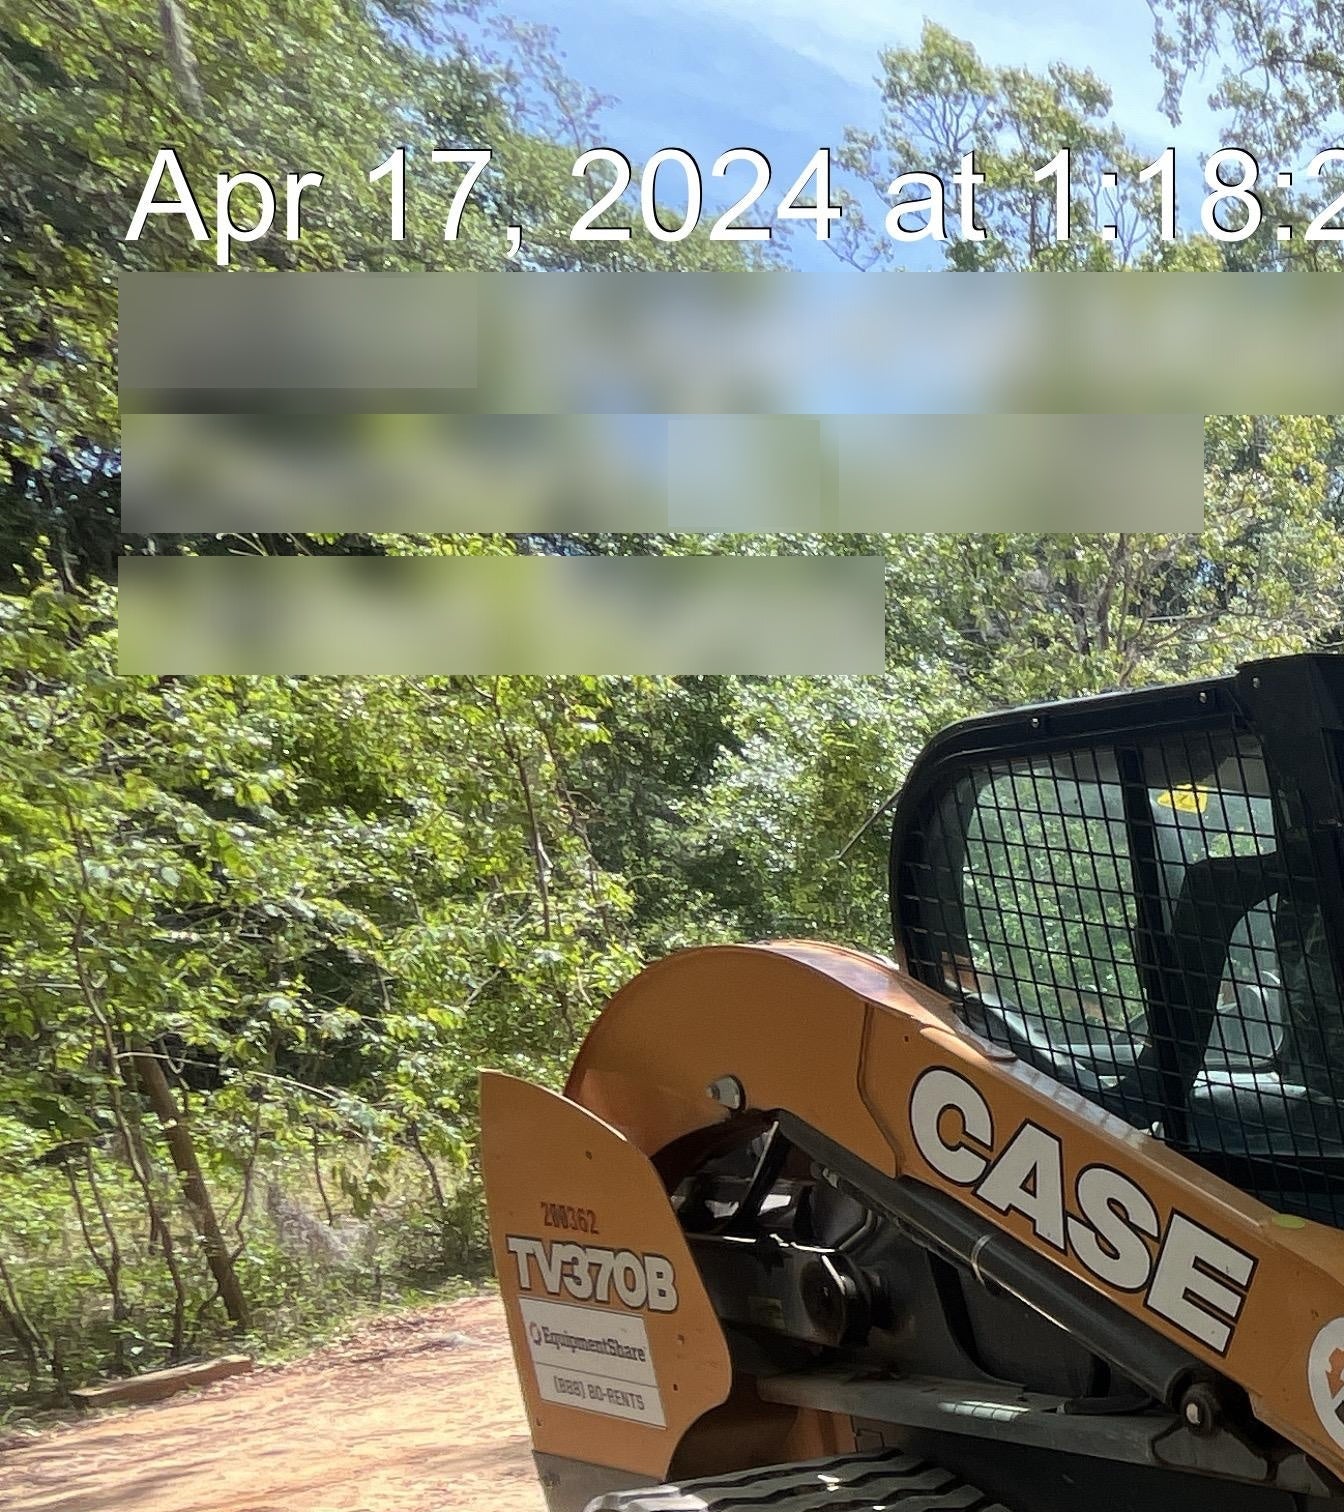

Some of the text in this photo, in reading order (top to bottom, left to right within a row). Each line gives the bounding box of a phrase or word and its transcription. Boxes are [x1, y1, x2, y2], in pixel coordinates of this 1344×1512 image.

[909, 1065, 1259, 1357] CASE
[505, 1233, 679, 1315] TV370B
[541, 1325, 647, 1363] EquipmentShare
